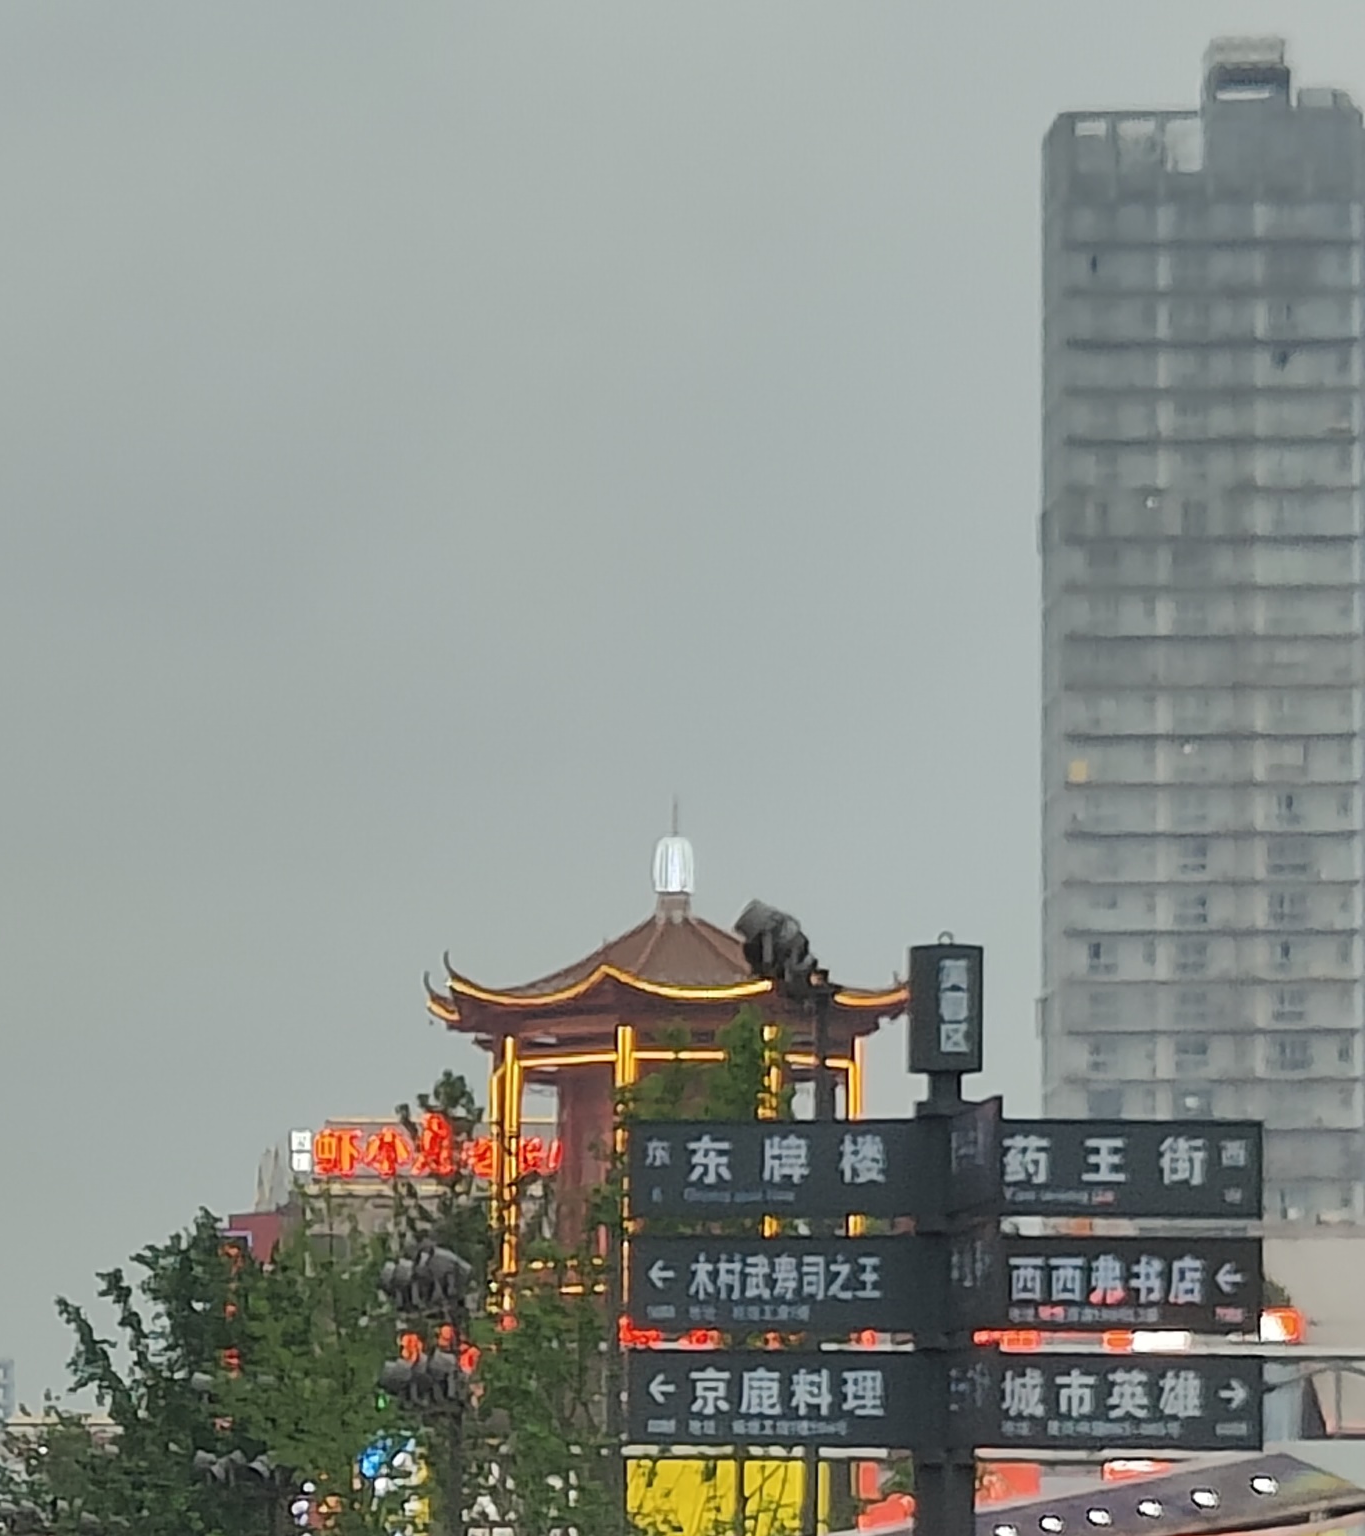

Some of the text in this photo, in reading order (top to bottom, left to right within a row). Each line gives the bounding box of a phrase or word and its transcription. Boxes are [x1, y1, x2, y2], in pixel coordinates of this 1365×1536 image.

[686, 1134, 887, 1184] 东牌楼
[1002, 1135, 1207, 1186] 药王街
[689, 1252, 882, 1300] 木村武寿司之王
[1008, 1253, 1205, 1304] 西西弗书店
[689, 1366, 885, 1416] 京鹿料理
[1001, 1368, 1202, 1419] 城市英雄
